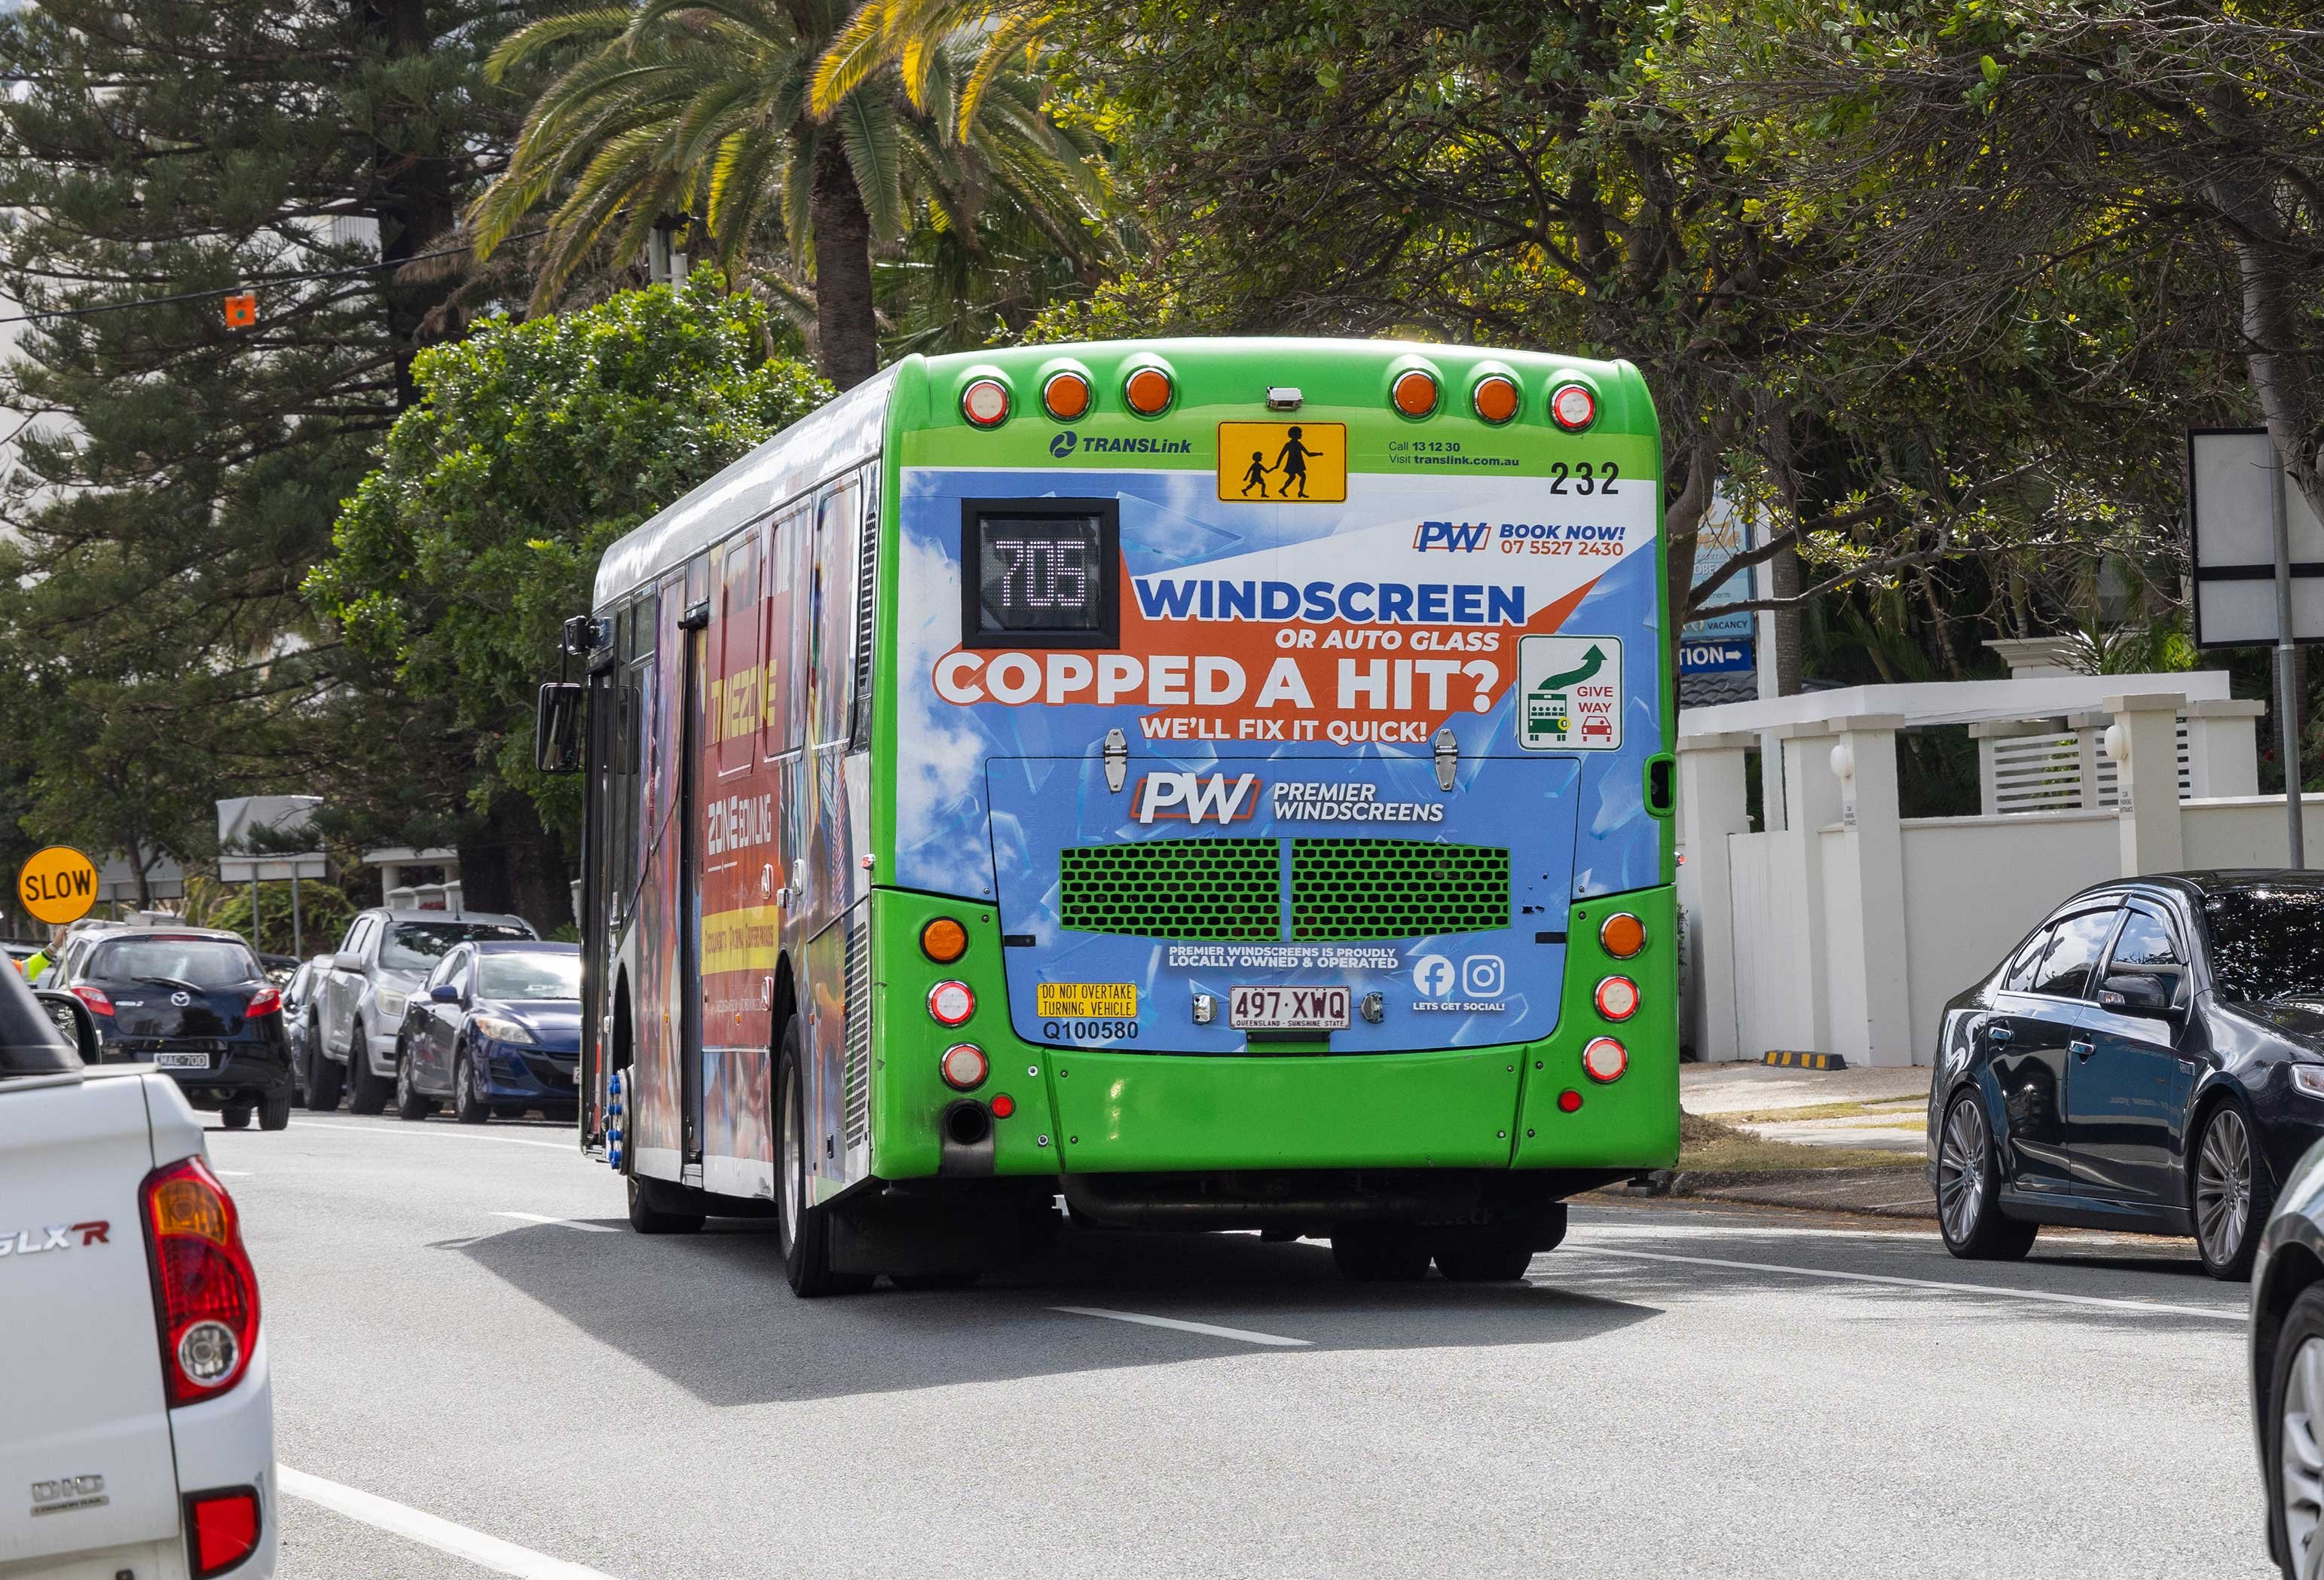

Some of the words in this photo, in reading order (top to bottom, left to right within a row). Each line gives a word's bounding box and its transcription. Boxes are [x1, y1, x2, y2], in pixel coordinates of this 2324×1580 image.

[1082, 437, 1192, 454] TRANSLink
[1389, 442, 1409, 451] Call
[1412, 442, 1426, 451] 13
[1430, 442, 1442, 452] 12
[1445, 442, 1460, 452] 30
[1390, 454, 1411, 464] Visit
[1414, 455, 1519, 466] translink.com.au
[1549, 461, 1619, 496] 232
[1417, 521, 1488, 552] PW
[1499, 524, 1561, 539] BOOK
[1565, 525, 1625, 541] NOW!
[1500, 540, 1523, 555] 07
[1529, 540, 1572, 555] 5527
[1577, 541, 1624, 556] 2430
[995, 540, 1085, 607] 705
[1136, 579, 1525, 624] WINDSCREEN
[1707, 620, 1748, 630] VACANCY
[1275, 628, 1316, 649] OR
[1323, 630, 1402, 650] AUTO
[1410, 631, 1500, 652] GLASS
[1679, 646, 1724, 665] TION
[934, 652, 1246, 705] COPPED
[1255, 657, 1315, 708] A
[1338, 659, 1500, 713] HIT?
[1577, 686, 1613, 698] GIVE
[711, 659, 777, 745] TIMEZONE
[1579, 702, 1612, 713] WAY
[1139, 718, 1230, 739] WE'LL
[1239, 720, 1285, 739] FIX
[1293, 720, 1319, 740] IT
[1326, 721, 1427, 746] QUICK!
[1139, 772, 1255, 824] PW
[1273, 783, 1375, 802] PREMIER
[1274, 802, 1444, 822] WINDSCREENS
[708, 795, 737, 855] ZONE
[739, 793, 772, 848] BOWLING
[26, 869, 90, 901] SLOW
[1170, 946, 1225, 956] PREMIER
[1227, 946, 1319, 957] WINDSCREENS
[1322, 948, 1334, 957] IS
[1337, 948, 1396, 958] PROUDLY
[1169, 955, 1237, 967] LOCALLY
[1240, 955, 1298, 967] OWNED
[1302, 957, 1313, 967] &
[1316, 957, 1399, 969] OPERATED
[1041, 985, 1055, 999] DO
[1060, 985, 1078, 999] NOT
[1081, 985, 1133, 1000] OVERTAKE
[1043, 1001, 1084, 1016] TURNING
[1091, 1001, 1132, 1016] VEHICLE
[1413, 1002, 1439, 1010] LETS
[1463, 1003, 1506, 1011] SOCIAL!
[1042, 1022, 1139, 1039] Q100580
